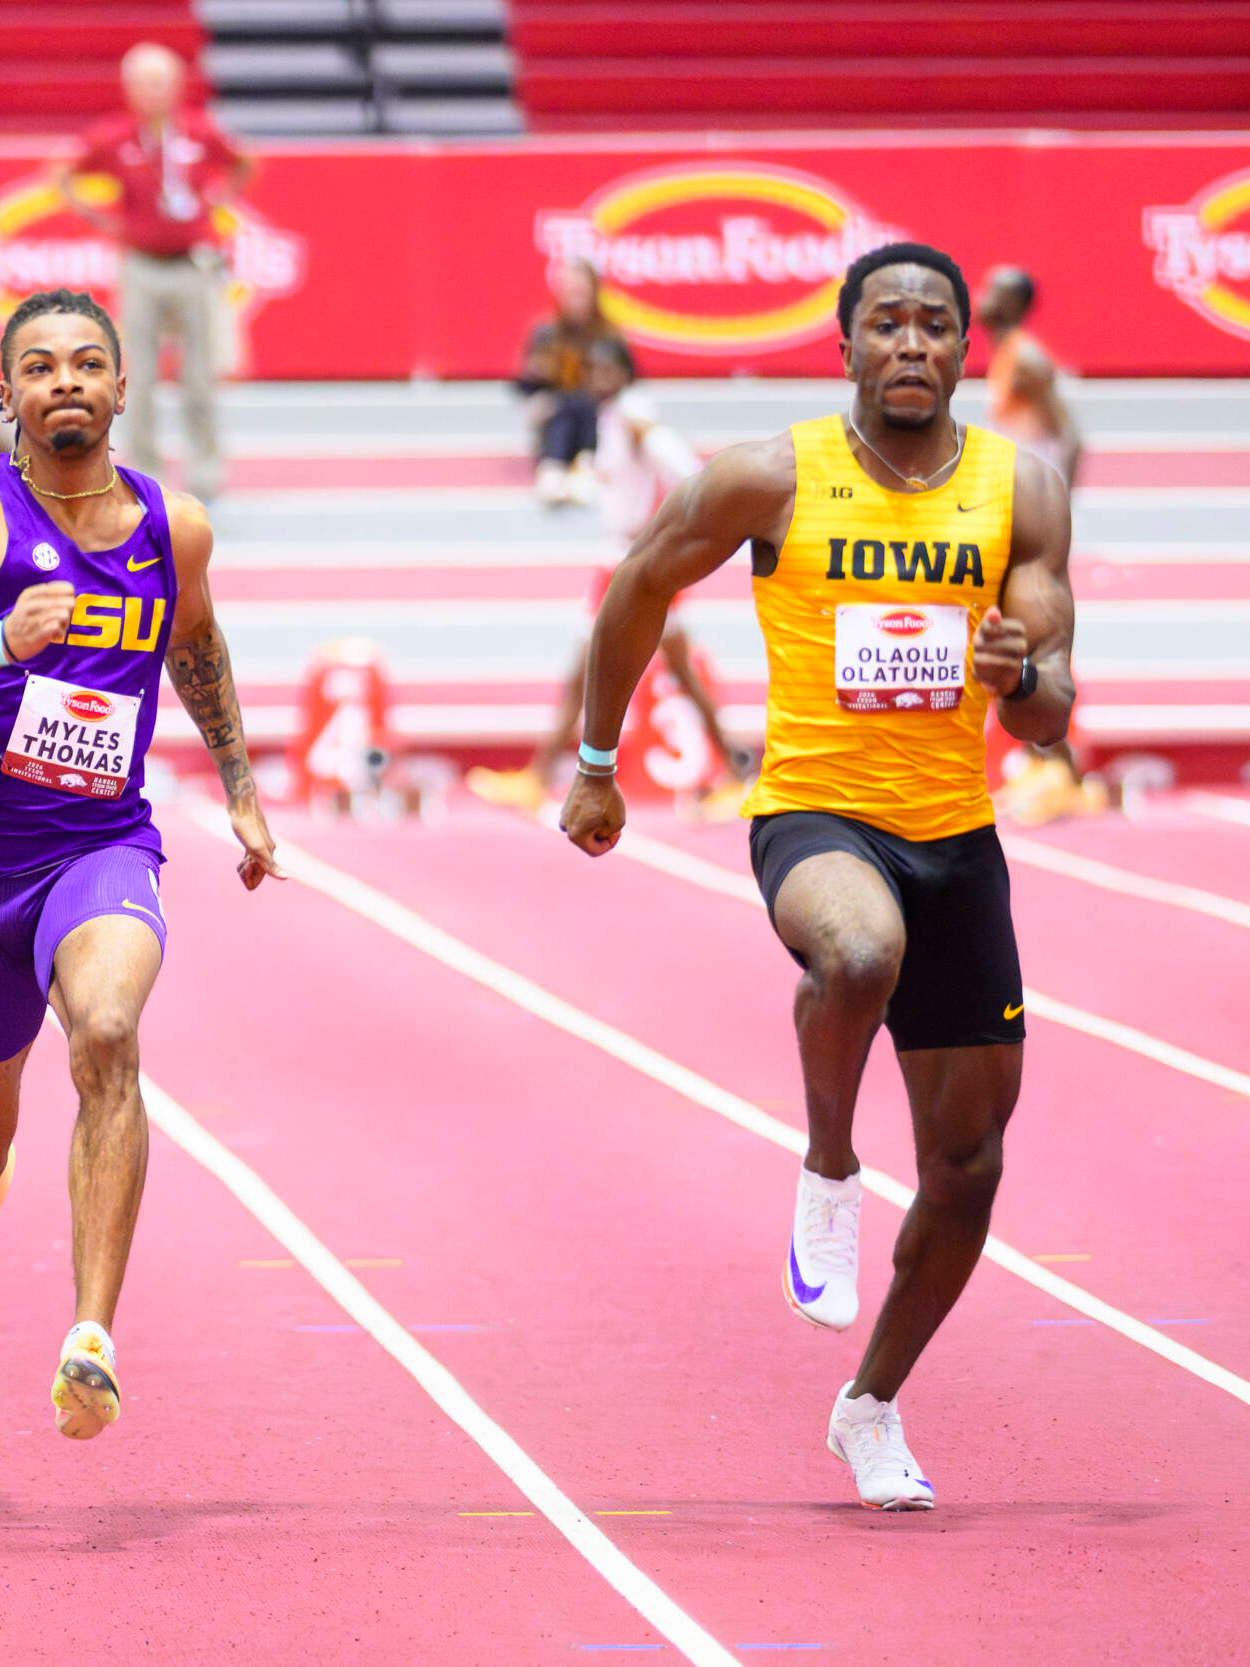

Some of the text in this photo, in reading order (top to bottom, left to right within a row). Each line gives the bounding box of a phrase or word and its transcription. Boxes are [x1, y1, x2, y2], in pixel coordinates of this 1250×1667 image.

[825, 538, 985, 588] IOWA
[52, 592, 166, 653] SU
[841, 664, 960, 683] OLATUNDE
[858, 646, 948, 664] OLAOLU
[23, 734, 124, 774] THOMAS
[38, 717, 121, 751] MYLES
[644, 696, 708, 789] 3
